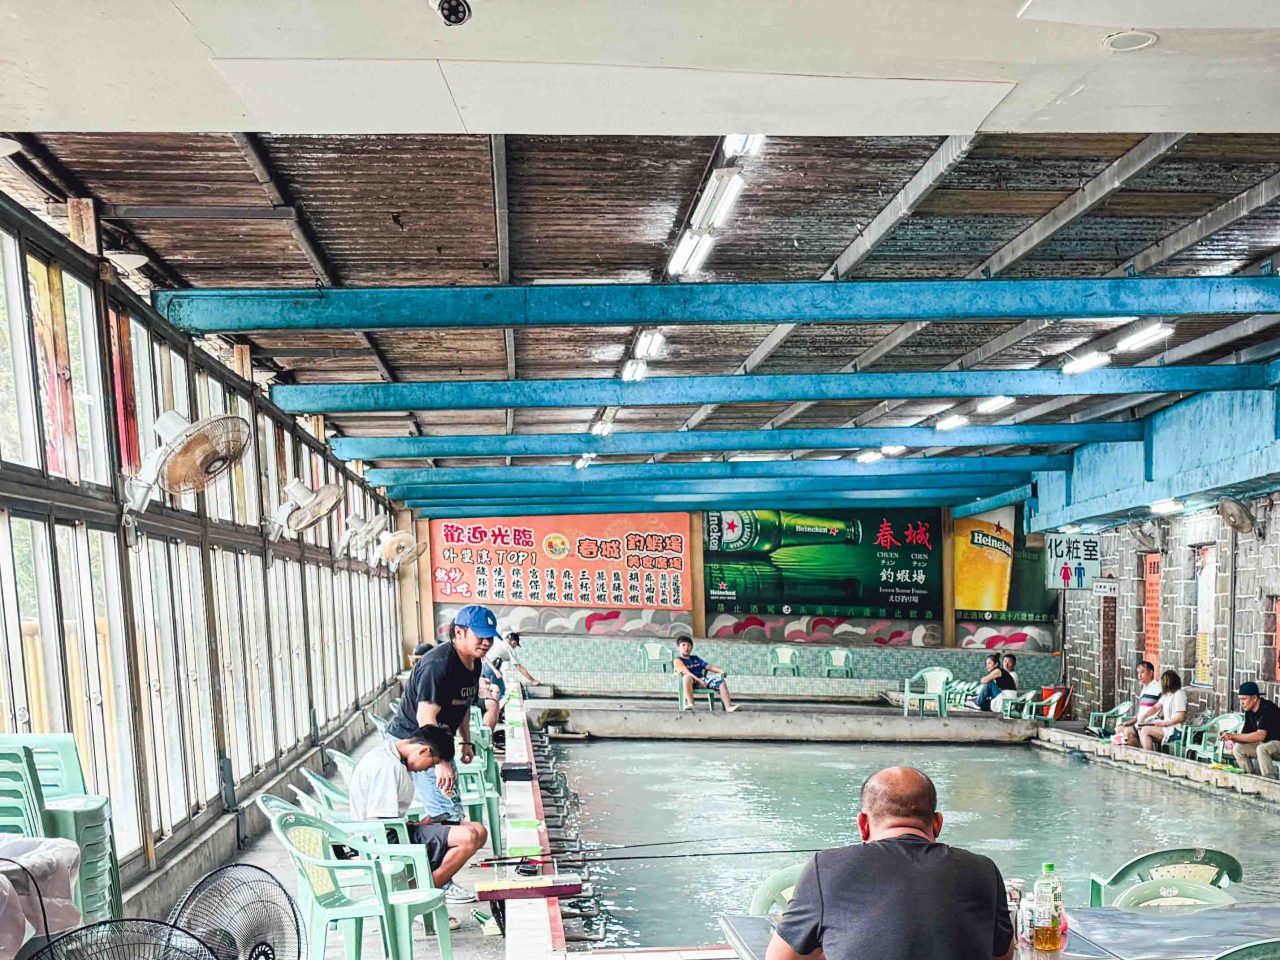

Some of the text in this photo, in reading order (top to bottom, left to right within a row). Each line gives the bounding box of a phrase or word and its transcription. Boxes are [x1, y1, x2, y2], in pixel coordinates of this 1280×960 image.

[443, 523, 535, 548] 歡迎光臨
[796, 525, 828, 534] Heineken
[873, 517, 934, 551] 春城
[577, 537, 622, 560] 春城
[626, 532, 683, 554] 釣蝦場
[1048, 537, 1099, 561] 化粧室
[443, 547, 492, 565] 外雙溪
[877, 551, 929, 560] CHUEN CHEN
[579, 570, 592, 603] 三杯蝦
[880, 567, 926, 585] 釣蝦場
